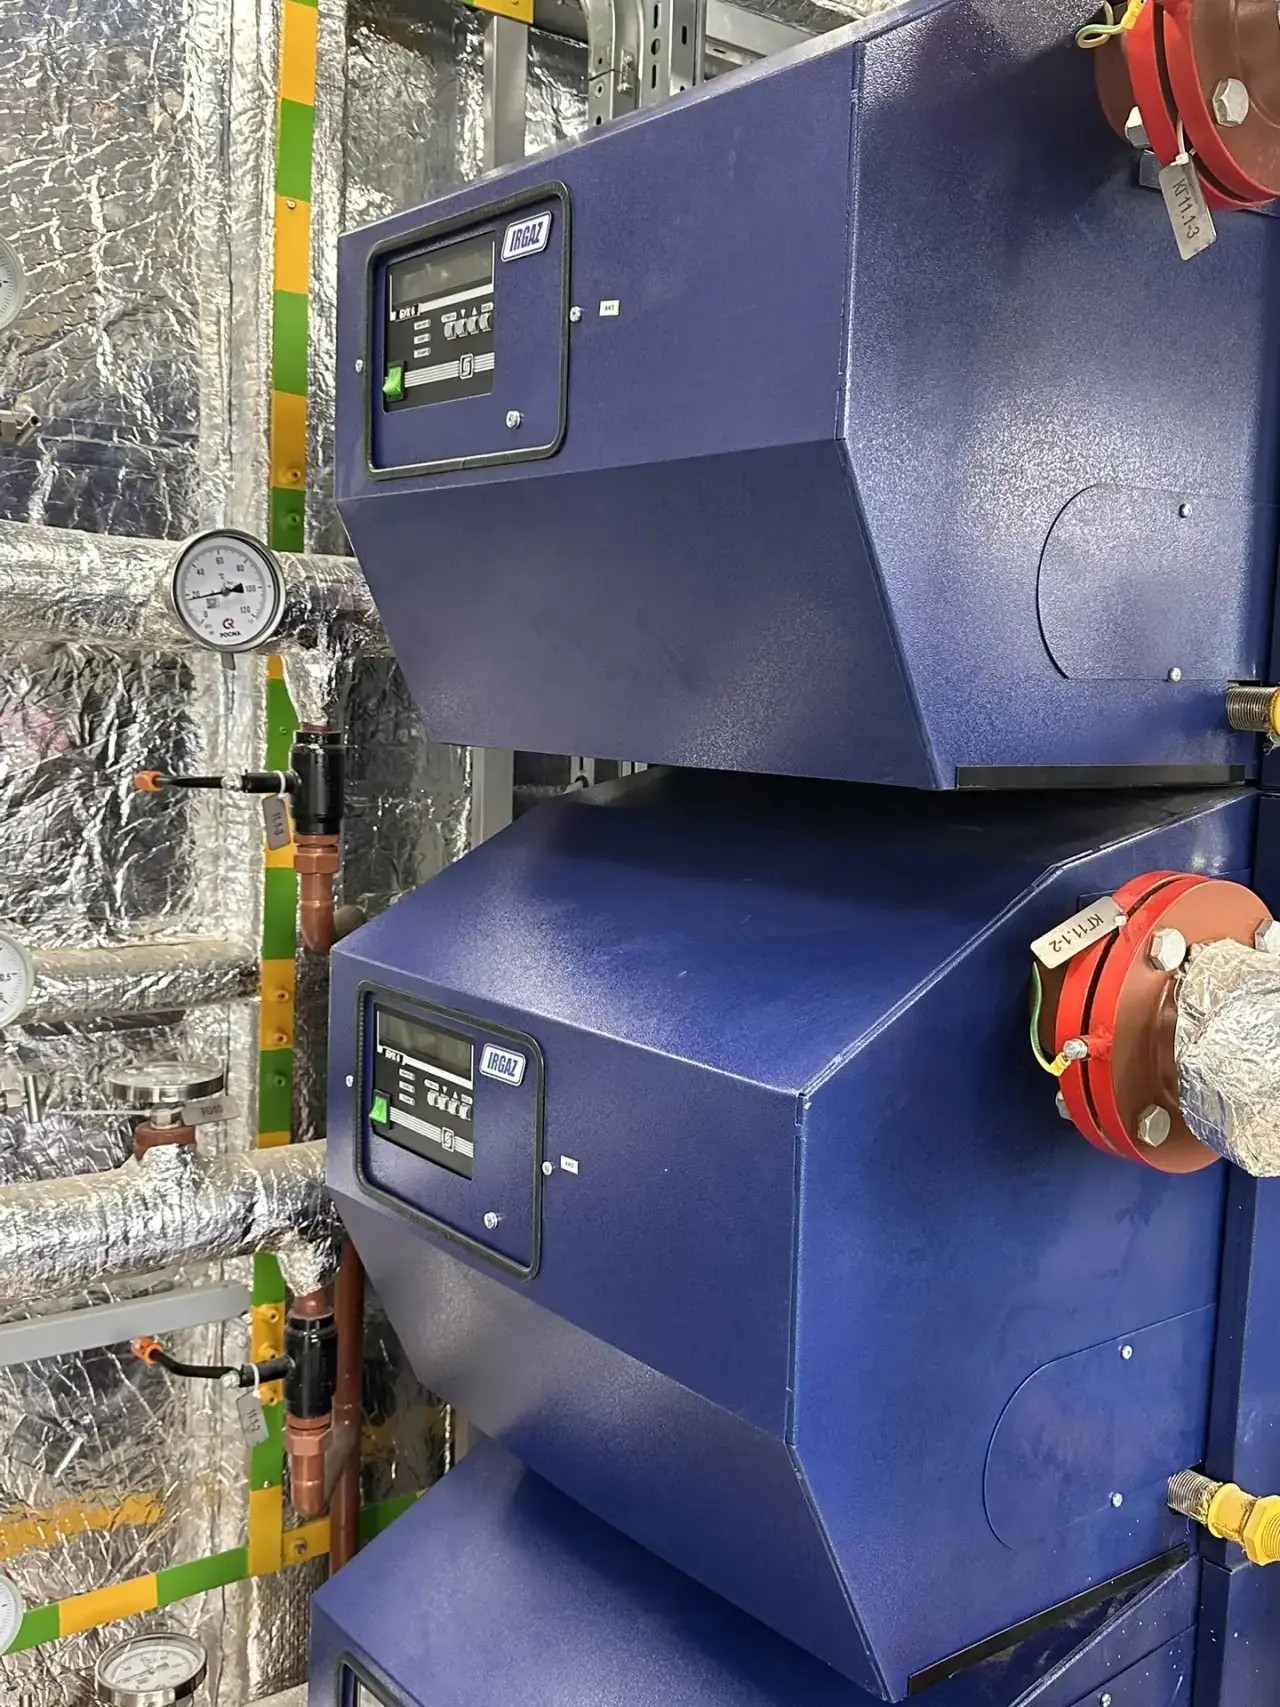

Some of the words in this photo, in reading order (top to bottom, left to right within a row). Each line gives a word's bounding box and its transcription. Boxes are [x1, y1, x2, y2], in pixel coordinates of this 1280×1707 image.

[509, 221, 544, 252] IRGAZ
[216, 556, 224, 565] 60
[197, 567, 205, 576] 40
[236, 564, 244, 572] 80
[245, 584, 257, 593] 100
[240, 605, 251, 614] 120
[487, 1051, 518, 1078] IRGAZ
